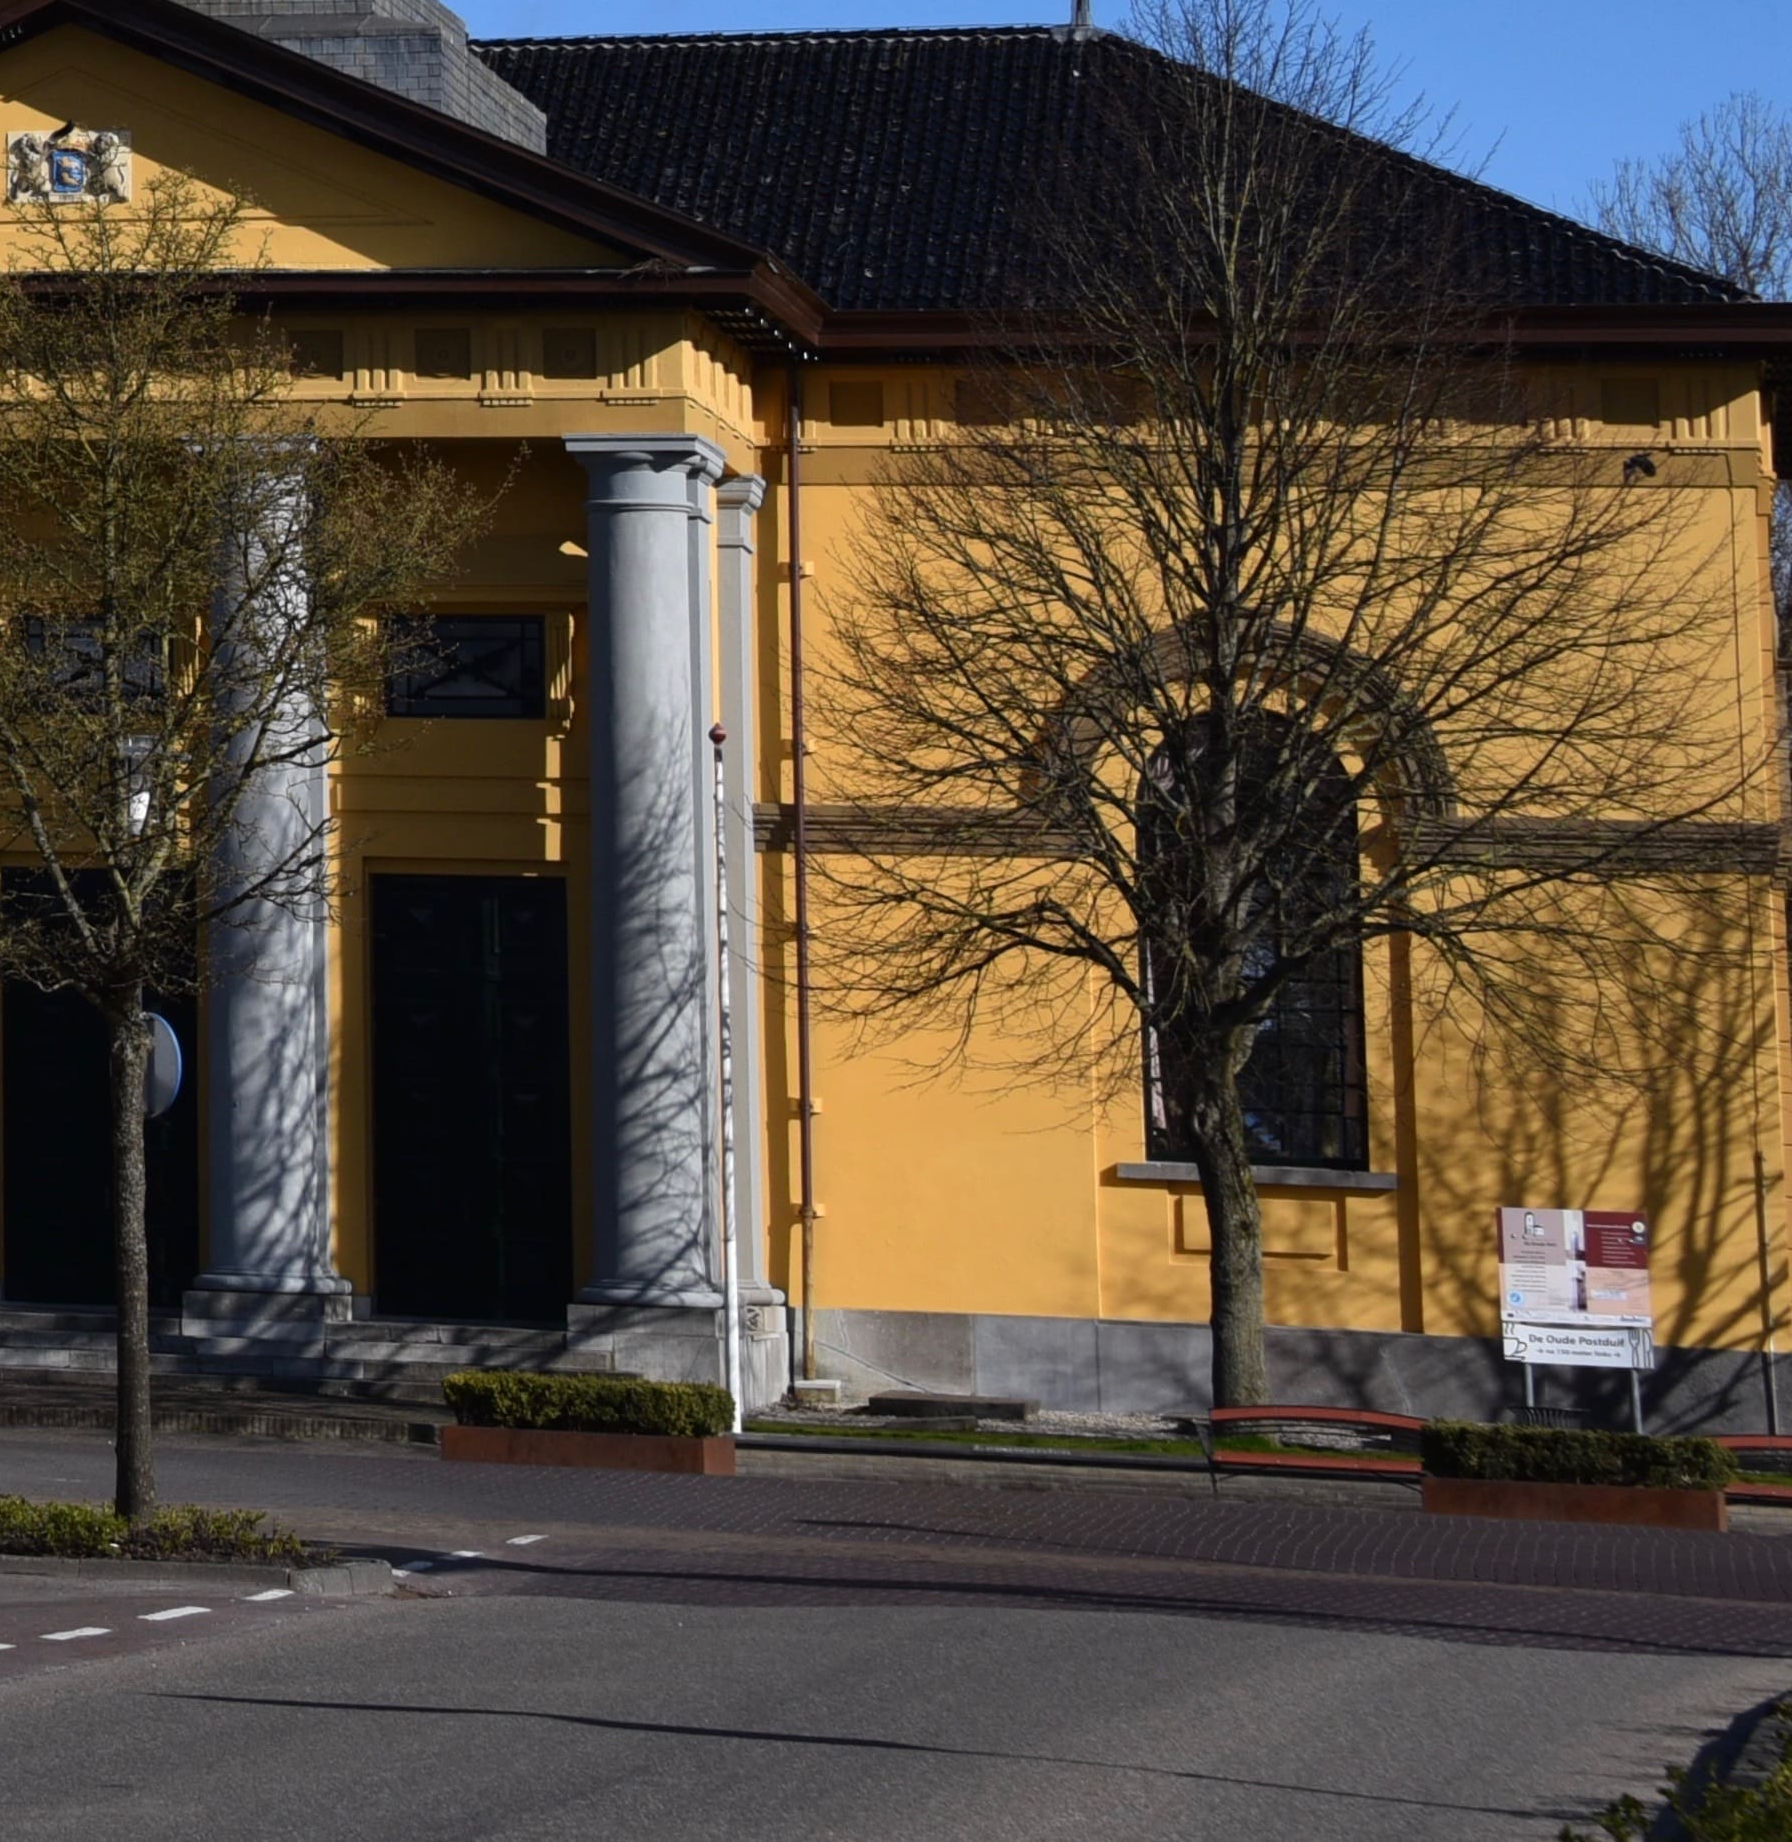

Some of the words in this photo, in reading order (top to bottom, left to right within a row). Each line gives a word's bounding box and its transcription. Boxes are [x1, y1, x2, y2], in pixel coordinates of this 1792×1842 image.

[1528, 1333, 1544, 1344] De
[1545, 1334, 1577, 1345] Oude
[1578, 1335, 1625, 1347] Postduif
